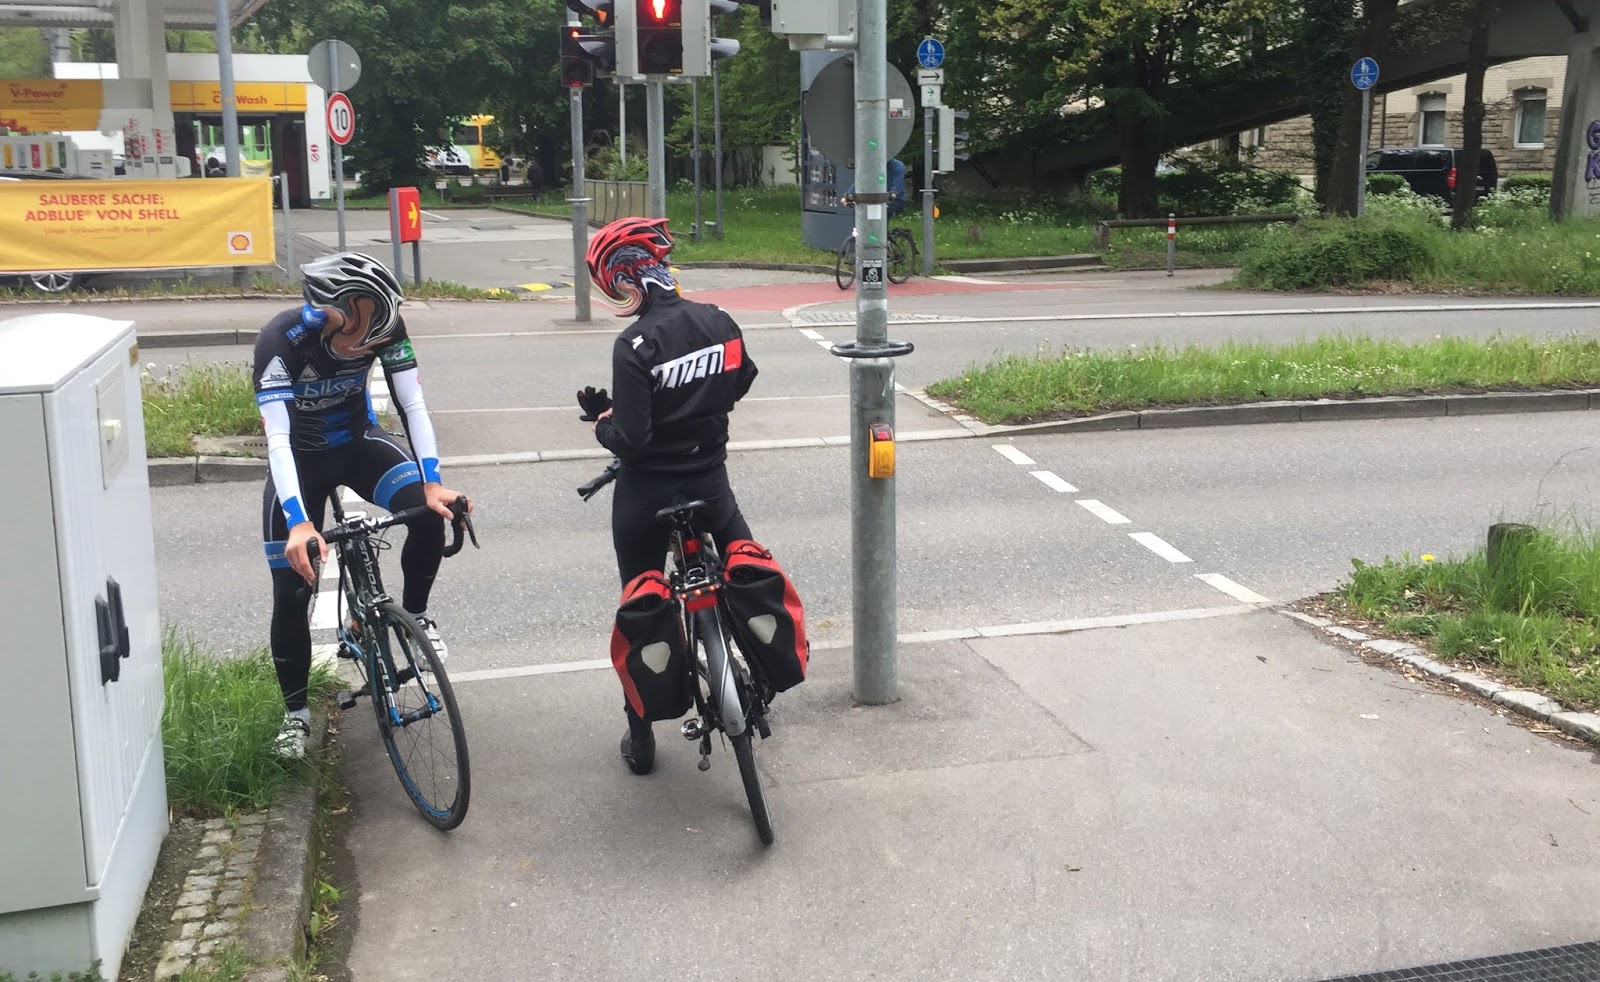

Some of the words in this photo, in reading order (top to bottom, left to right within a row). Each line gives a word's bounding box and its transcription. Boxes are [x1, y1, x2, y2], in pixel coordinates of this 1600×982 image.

[10, 88, 65, 98] V-Power
[236, 95, 268, 104] Wash
[335, 108, 348, 130] 10
[39, 194, 106, 206] SAUBERE
[112, 193, 164, 205] SACHE:
[96, 209, 133, 220] VON
[138, 208, 180, 220] SHELL
[304, 378, 356, 397] bike
